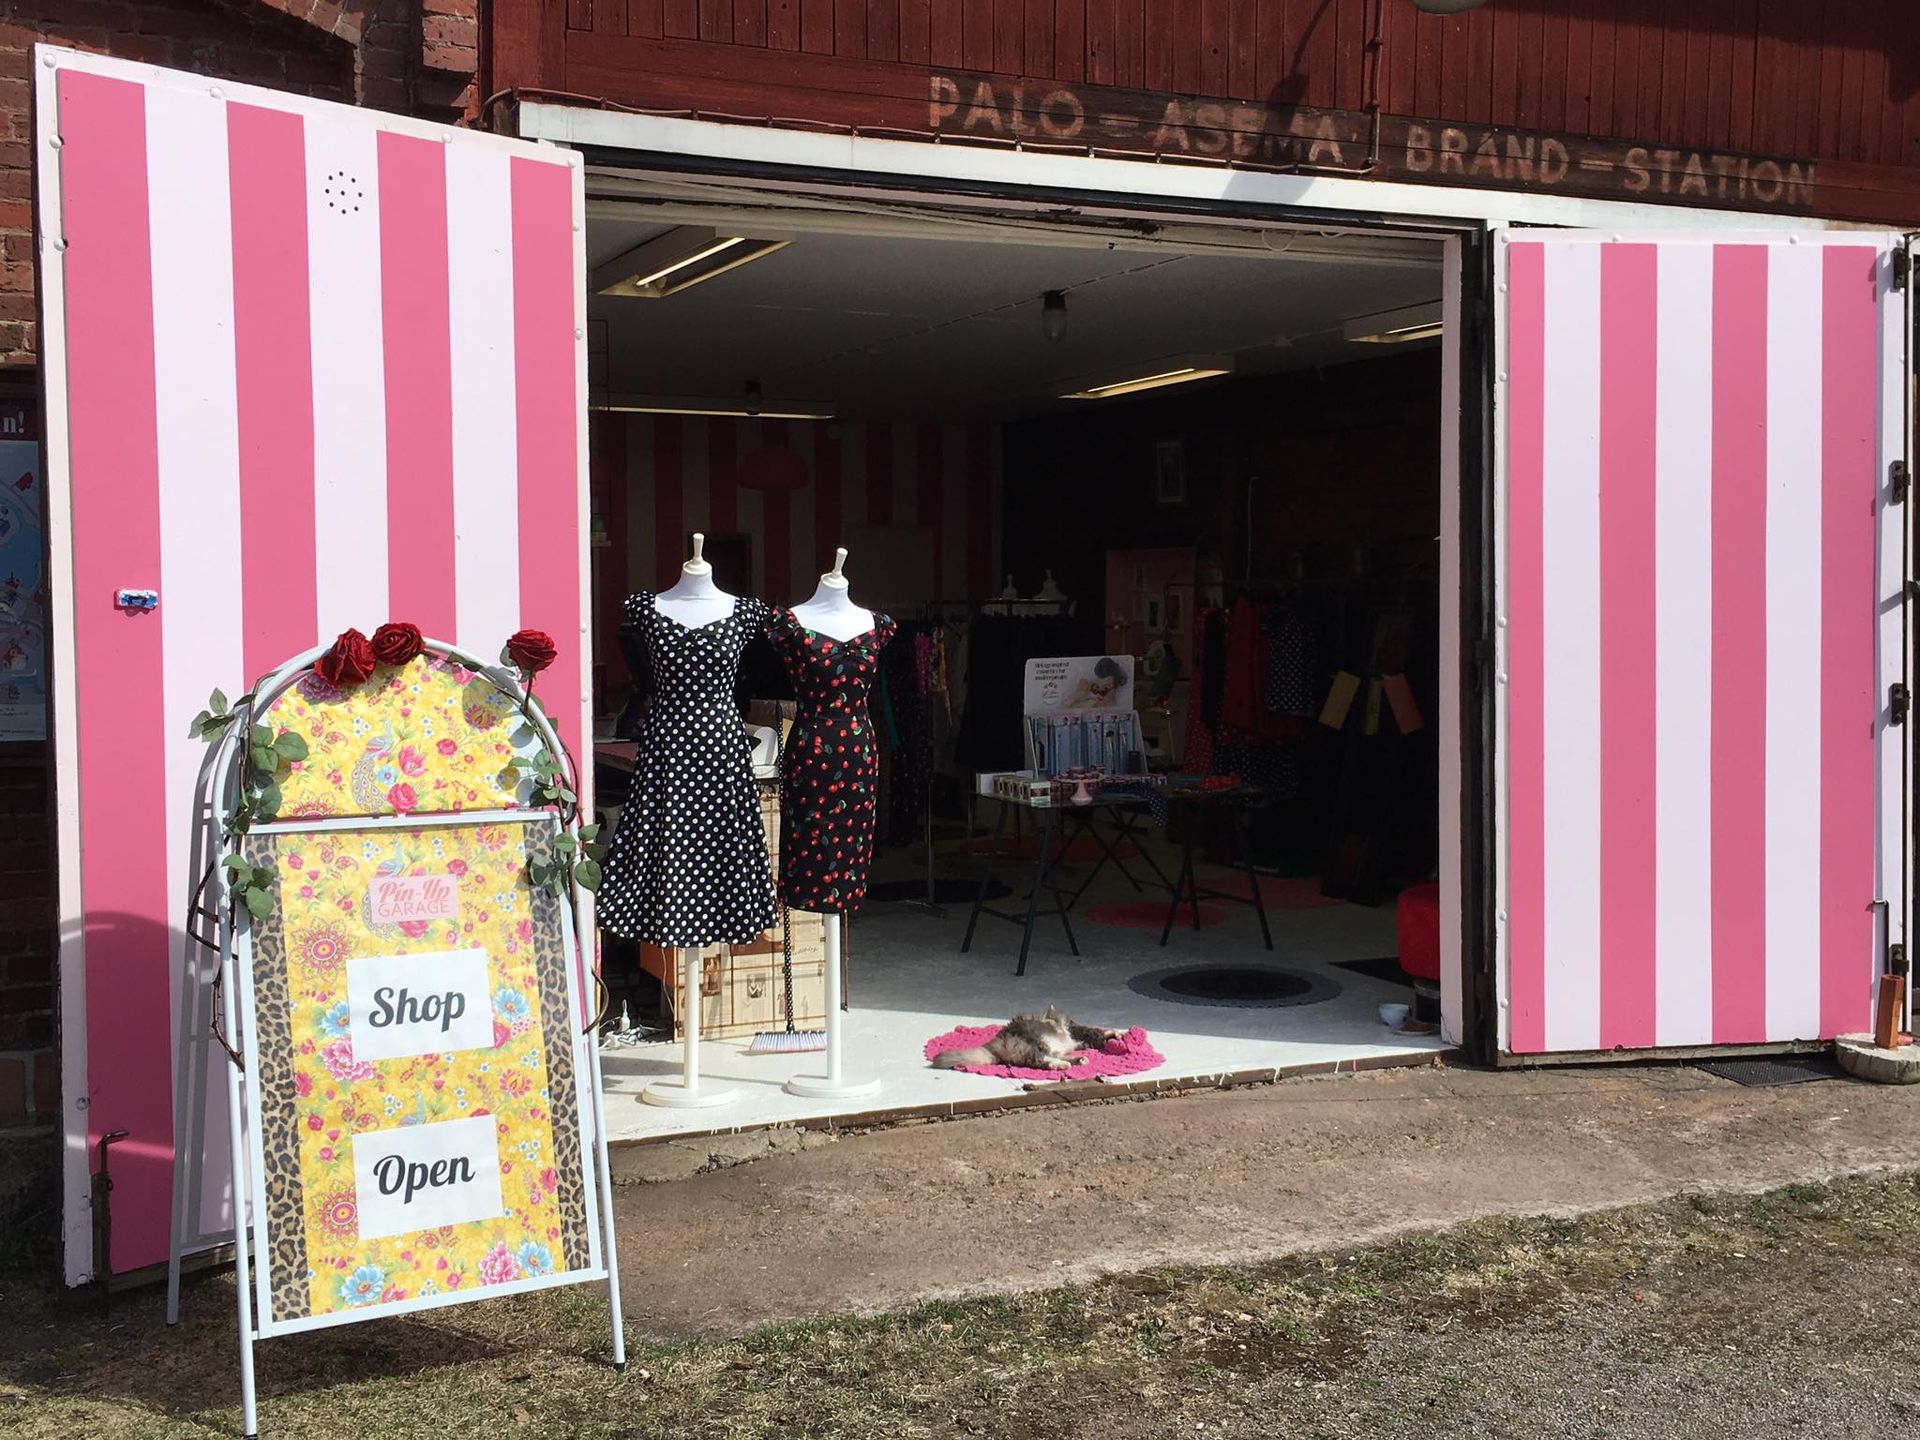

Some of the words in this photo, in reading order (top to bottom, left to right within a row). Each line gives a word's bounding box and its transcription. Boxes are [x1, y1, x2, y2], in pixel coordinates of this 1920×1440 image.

[929, 76, 1085, 137] PALO
[1406, 124, 1569, 184] BRAND
[1623, 147, 1816, 205] STATION
[377, 899, 451, 918] GARAGE
[378, 878, 451, 904] Pin-Up
[368, 986, 466, 1033] Shop
[372, 1154, 476, 1205] Open
